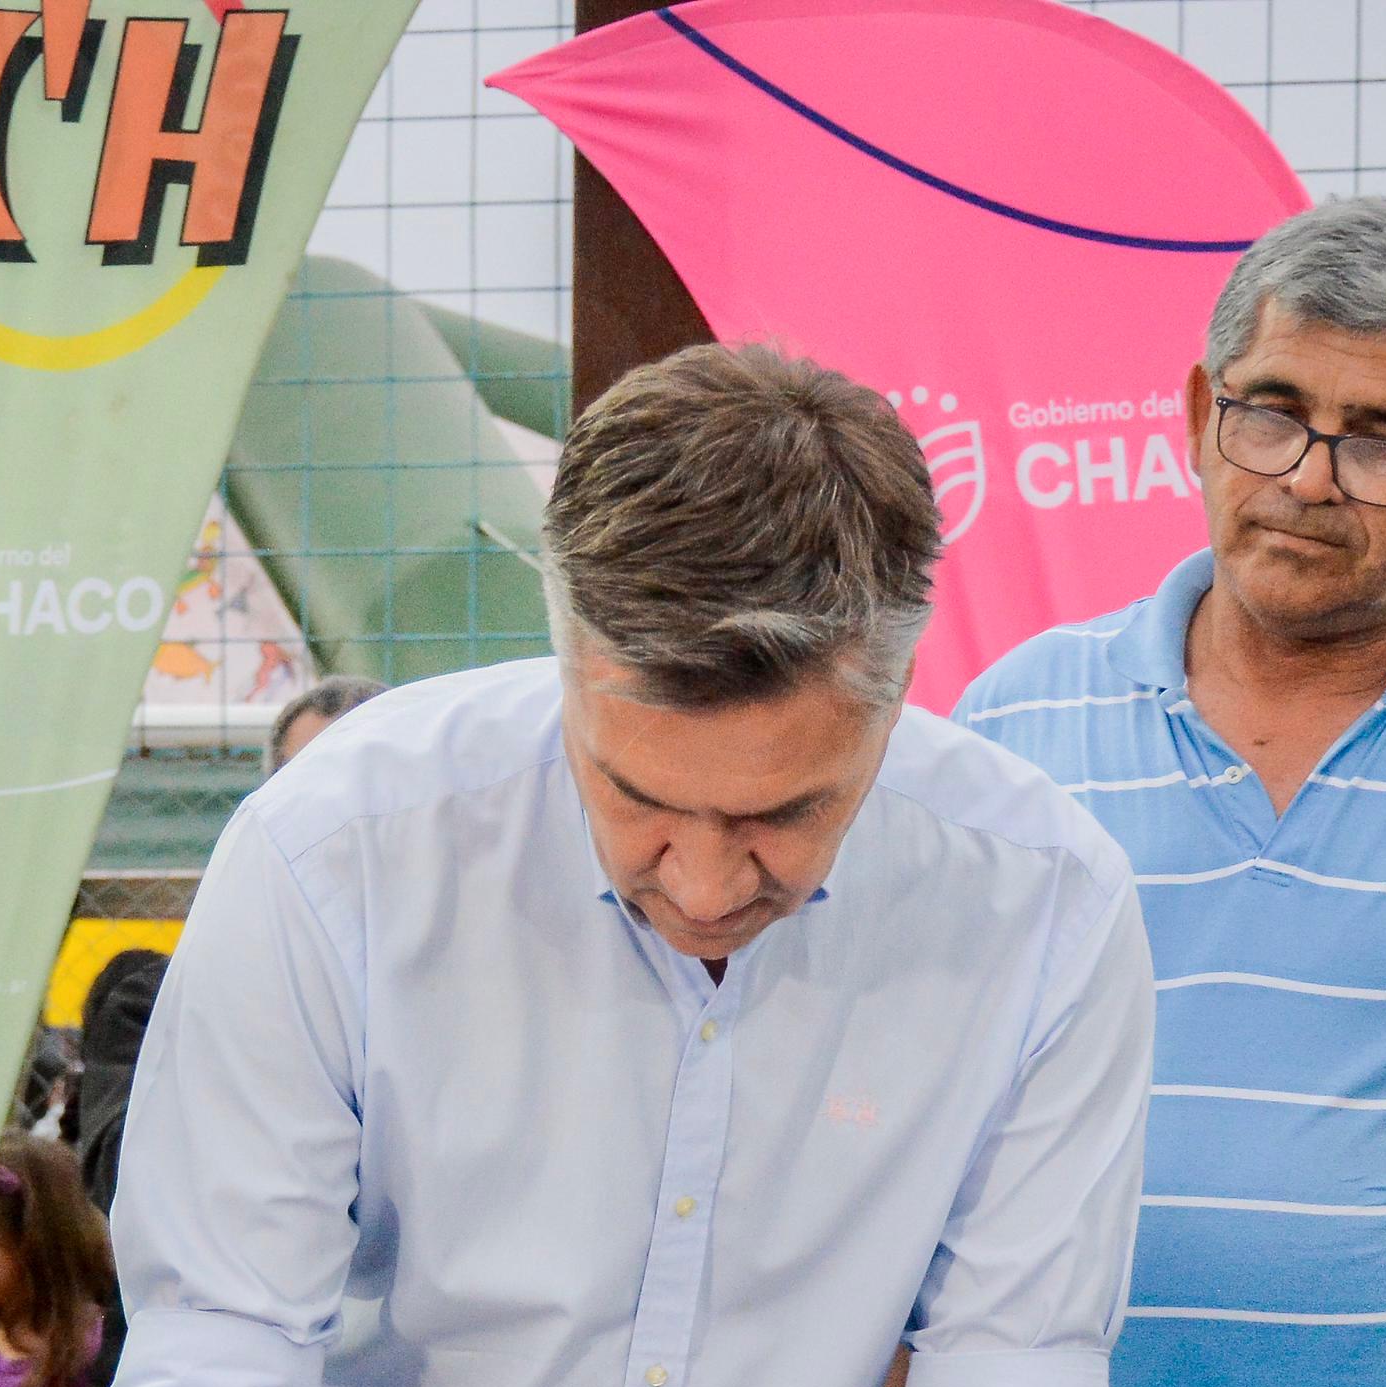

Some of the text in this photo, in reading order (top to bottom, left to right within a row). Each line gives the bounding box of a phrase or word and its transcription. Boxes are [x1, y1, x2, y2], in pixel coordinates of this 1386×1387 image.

[1008, 389, 1183, 429] Gobierno del
[1015, 433, 1202, 510] CHA
[37, 543, 71, 567] del
